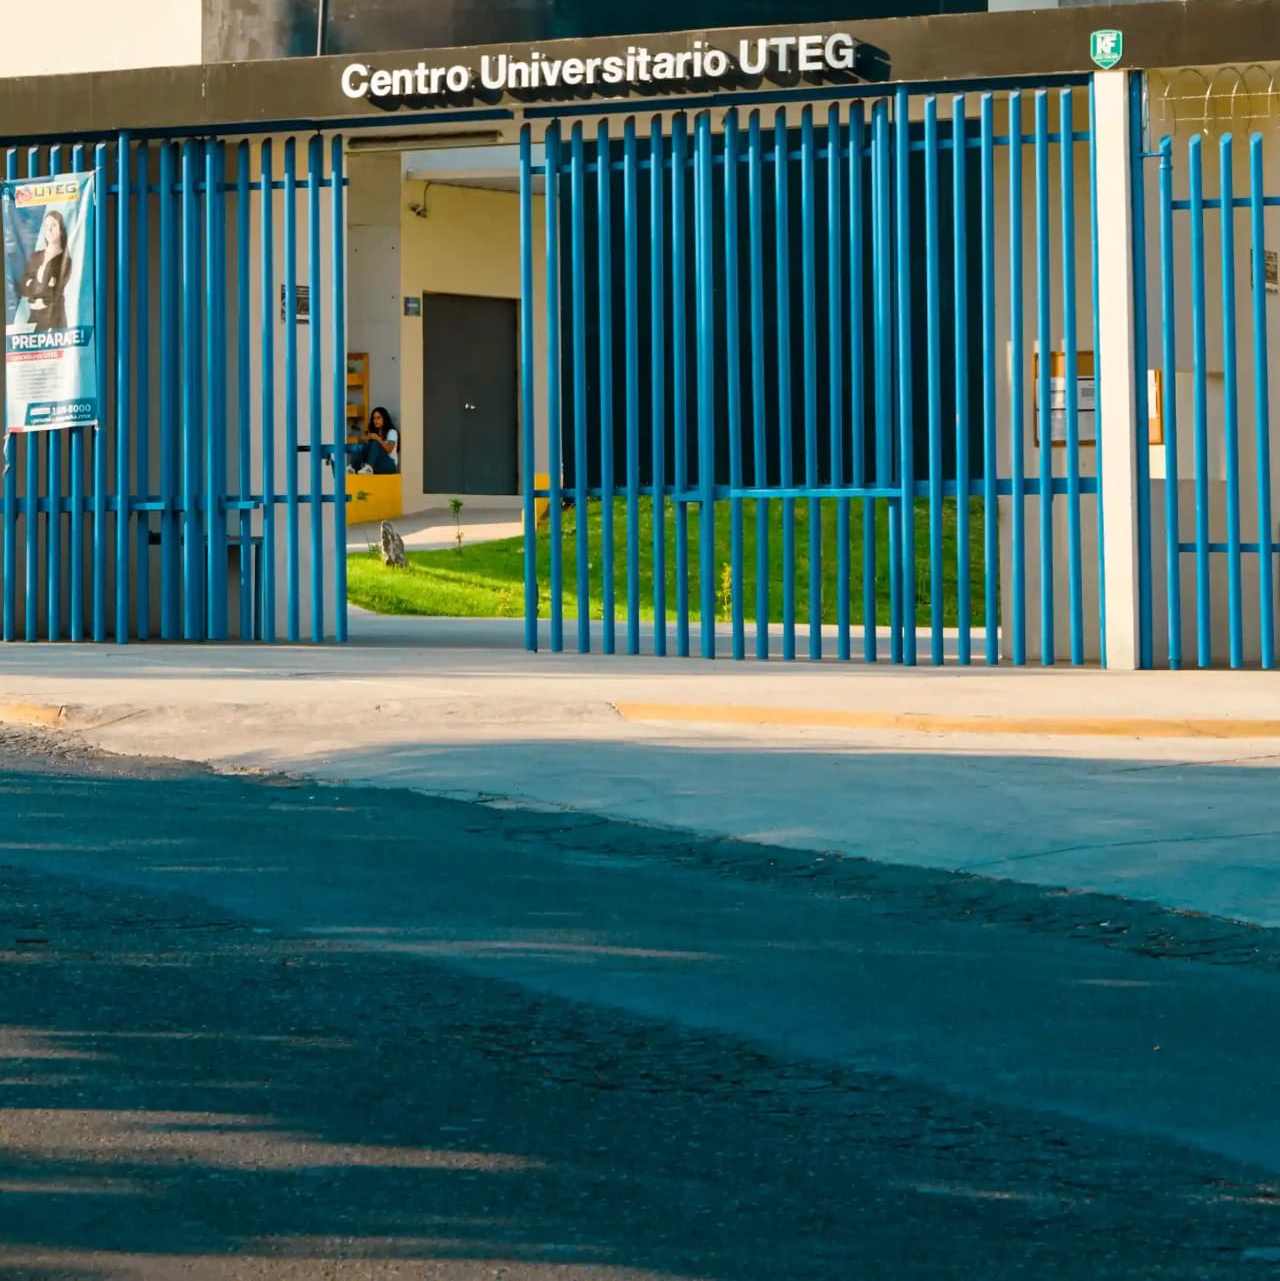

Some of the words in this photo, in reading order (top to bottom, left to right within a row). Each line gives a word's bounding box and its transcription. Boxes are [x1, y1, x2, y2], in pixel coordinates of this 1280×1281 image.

[341, 60, 470, 99] Centro
[480, 50, 727, 91] Universitario
[739, 33, 855, 75] UTEG
[34, 183, 76, 197] UTEG
